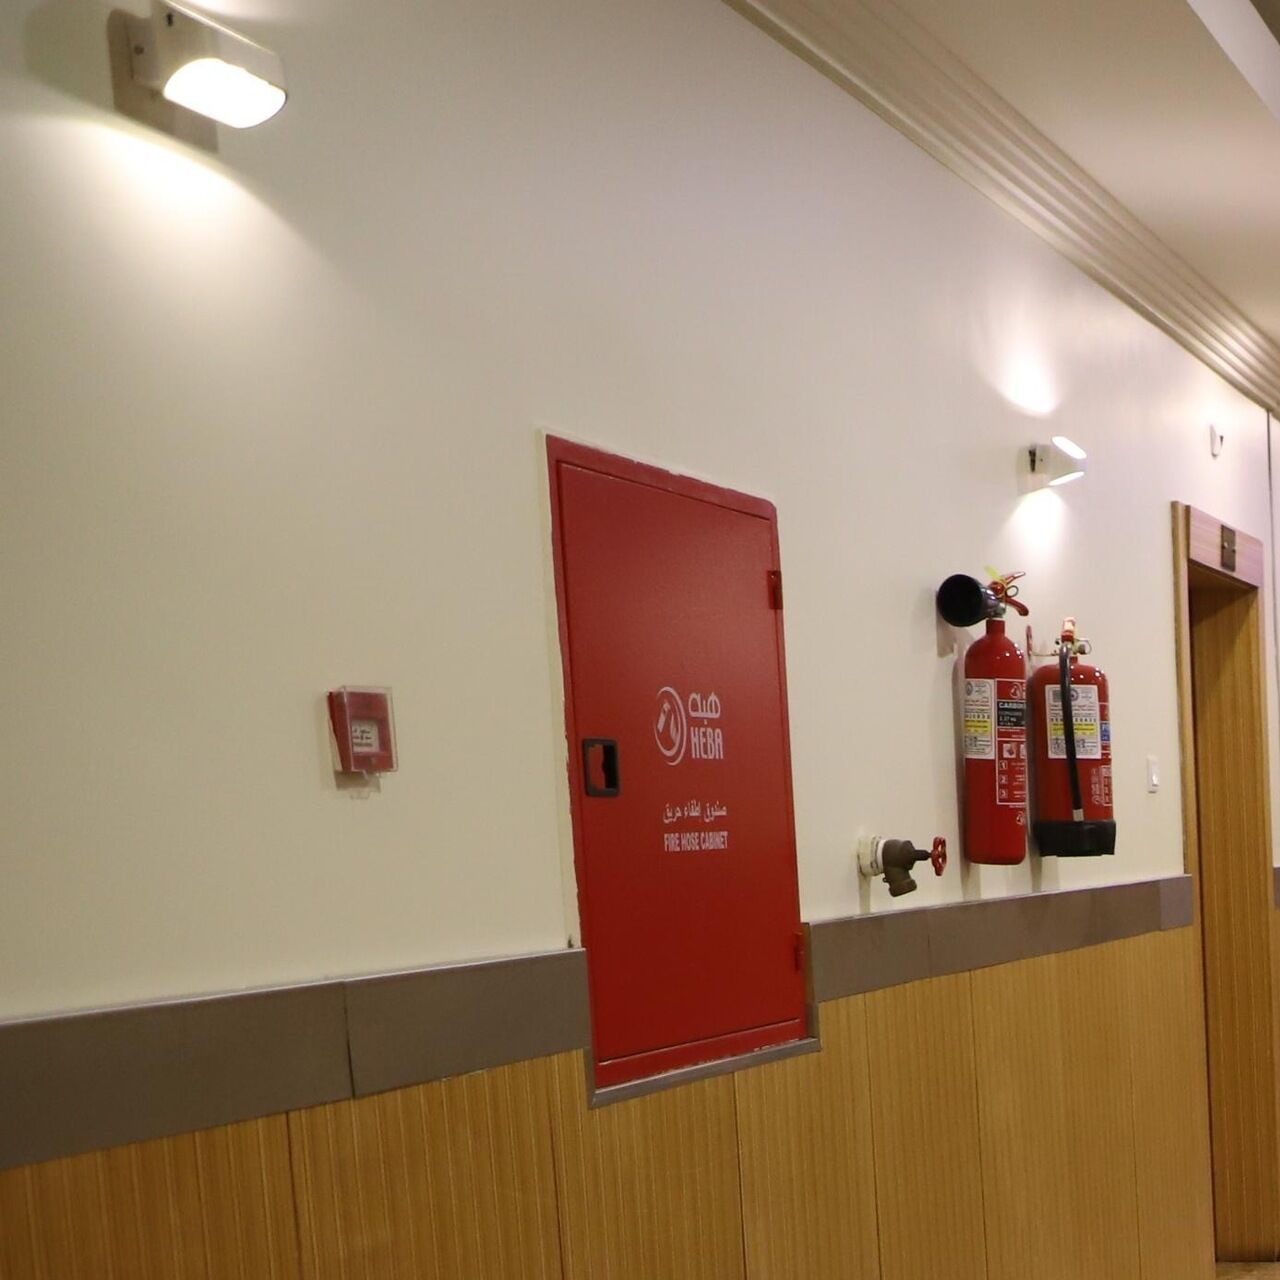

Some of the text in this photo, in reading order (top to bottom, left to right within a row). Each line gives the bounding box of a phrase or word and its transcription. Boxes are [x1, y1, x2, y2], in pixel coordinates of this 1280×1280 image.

[690, 727, 723, 759] HEBA
[663, 803, 682, 824] حريق
[704, 800, 727, 823] صندوق
[664, 831, 728, 851] FIRE HOSE CABINET
